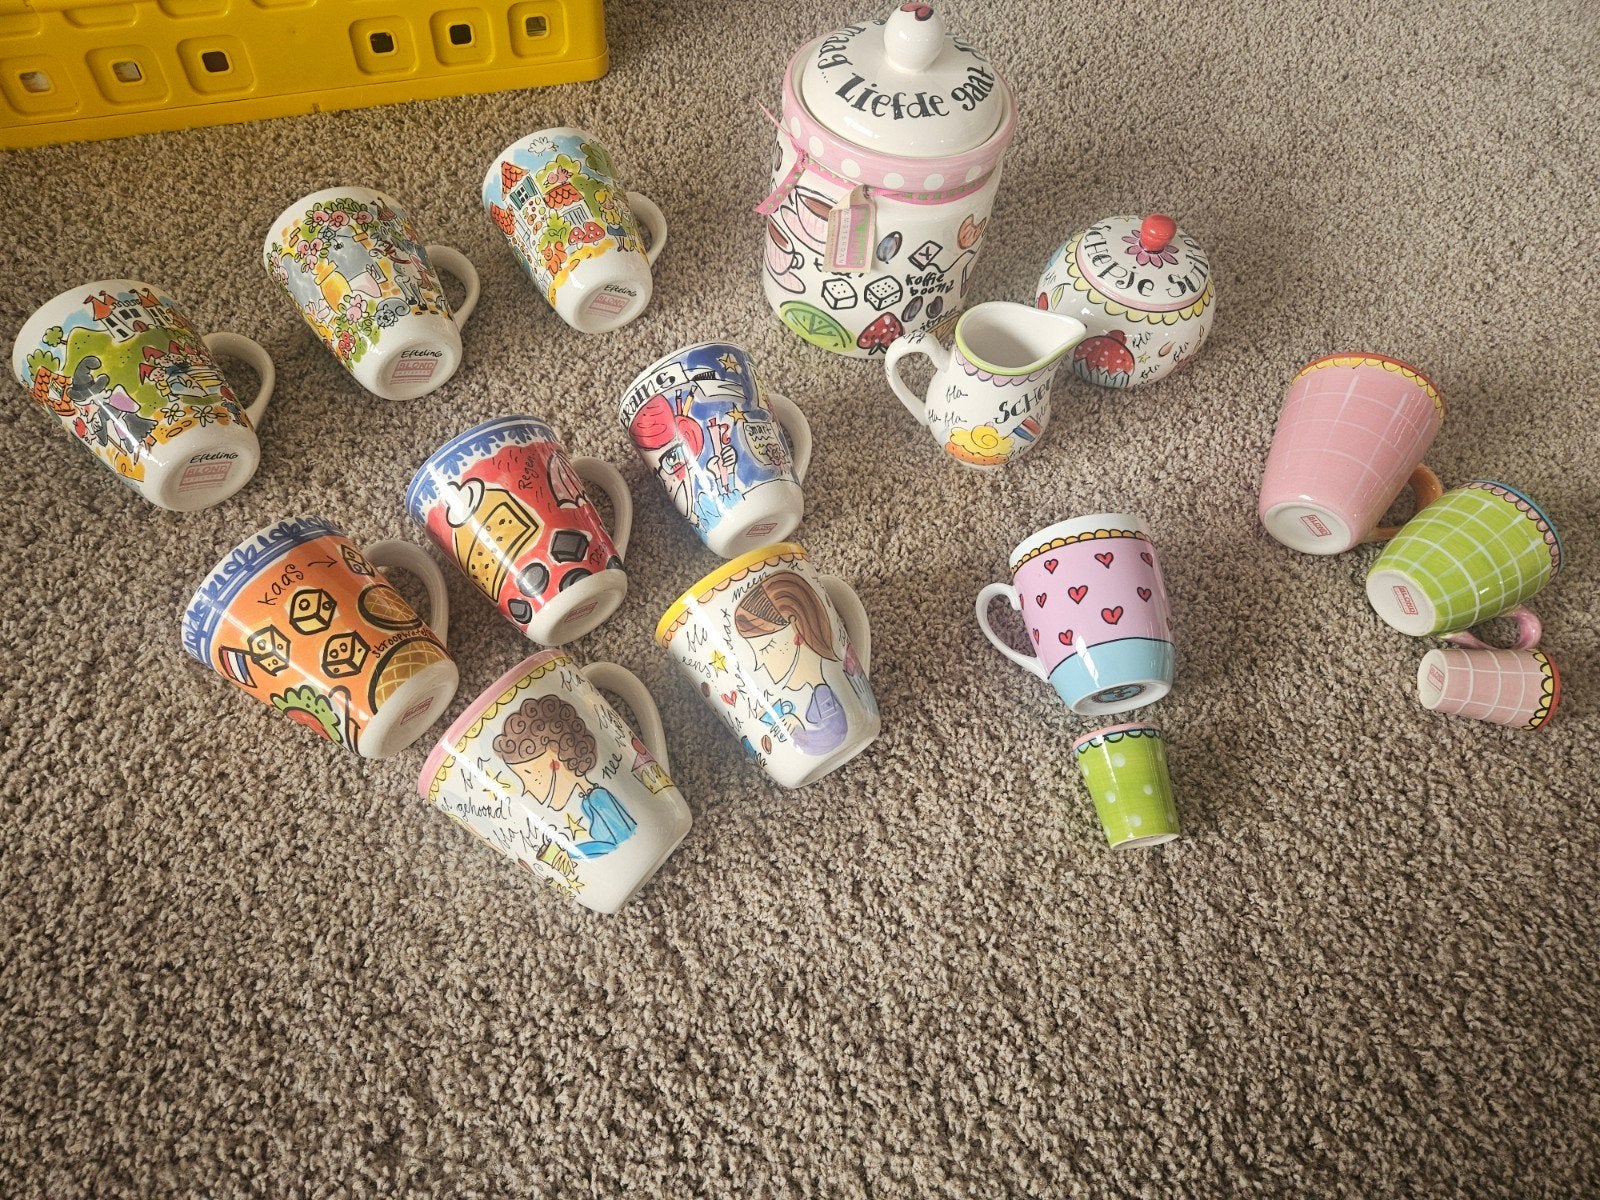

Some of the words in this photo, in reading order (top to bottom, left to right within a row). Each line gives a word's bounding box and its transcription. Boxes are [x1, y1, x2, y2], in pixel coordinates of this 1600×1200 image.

[835, 73, 950, 120] Liefde
[951, 66, 995, 111] gaat
[399, 361, 435, 370] BLOND
[186, 465, 228, 477] BLOND
[1308, 514, 1329, 535] BLOND
[1398, 587, 1416, 614] BLOND
